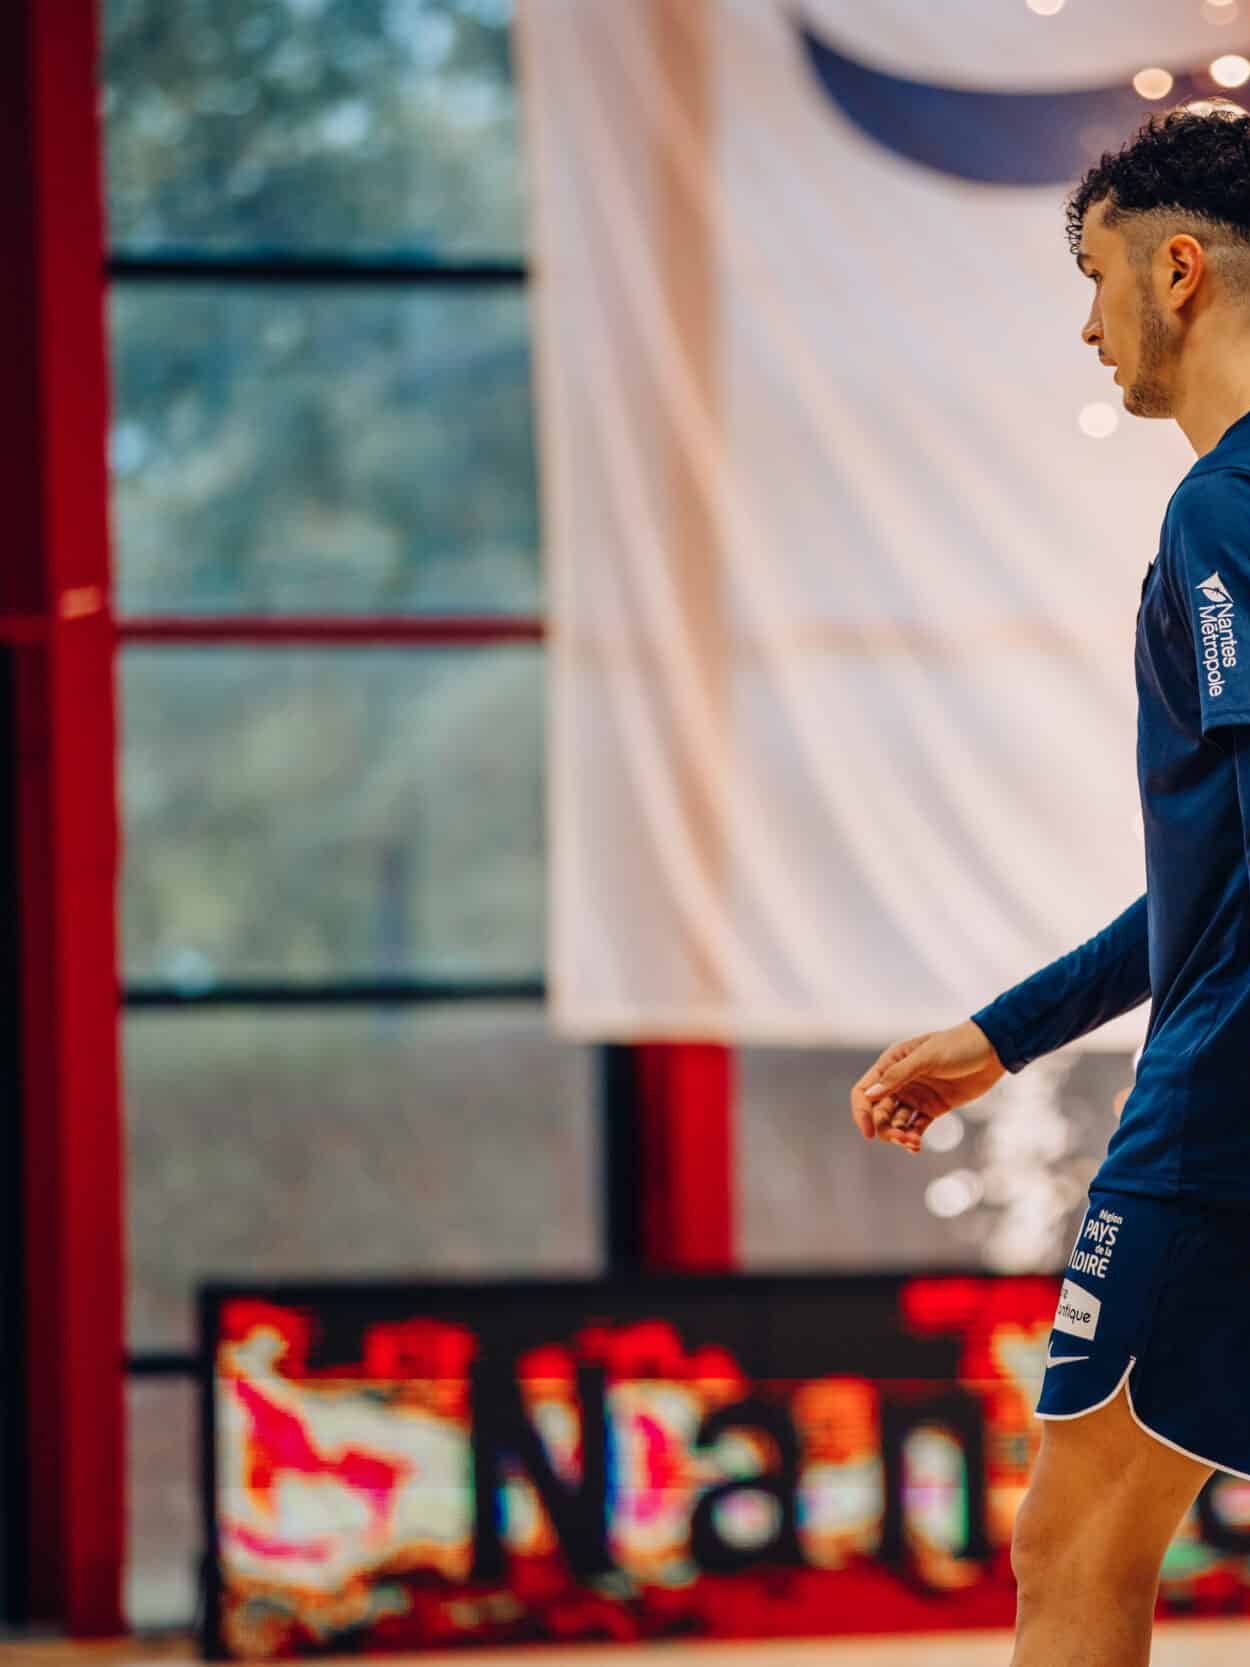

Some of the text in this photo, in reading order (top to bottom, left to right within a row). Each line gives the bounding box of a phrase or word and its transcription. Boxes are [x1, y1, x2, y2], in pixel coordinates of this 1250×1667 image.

[1198, 604, 1226, 697] Métropole
[1215, 602, 1238, 668] Nantes
[1083, 1218, 1120, 1247] PAYS
